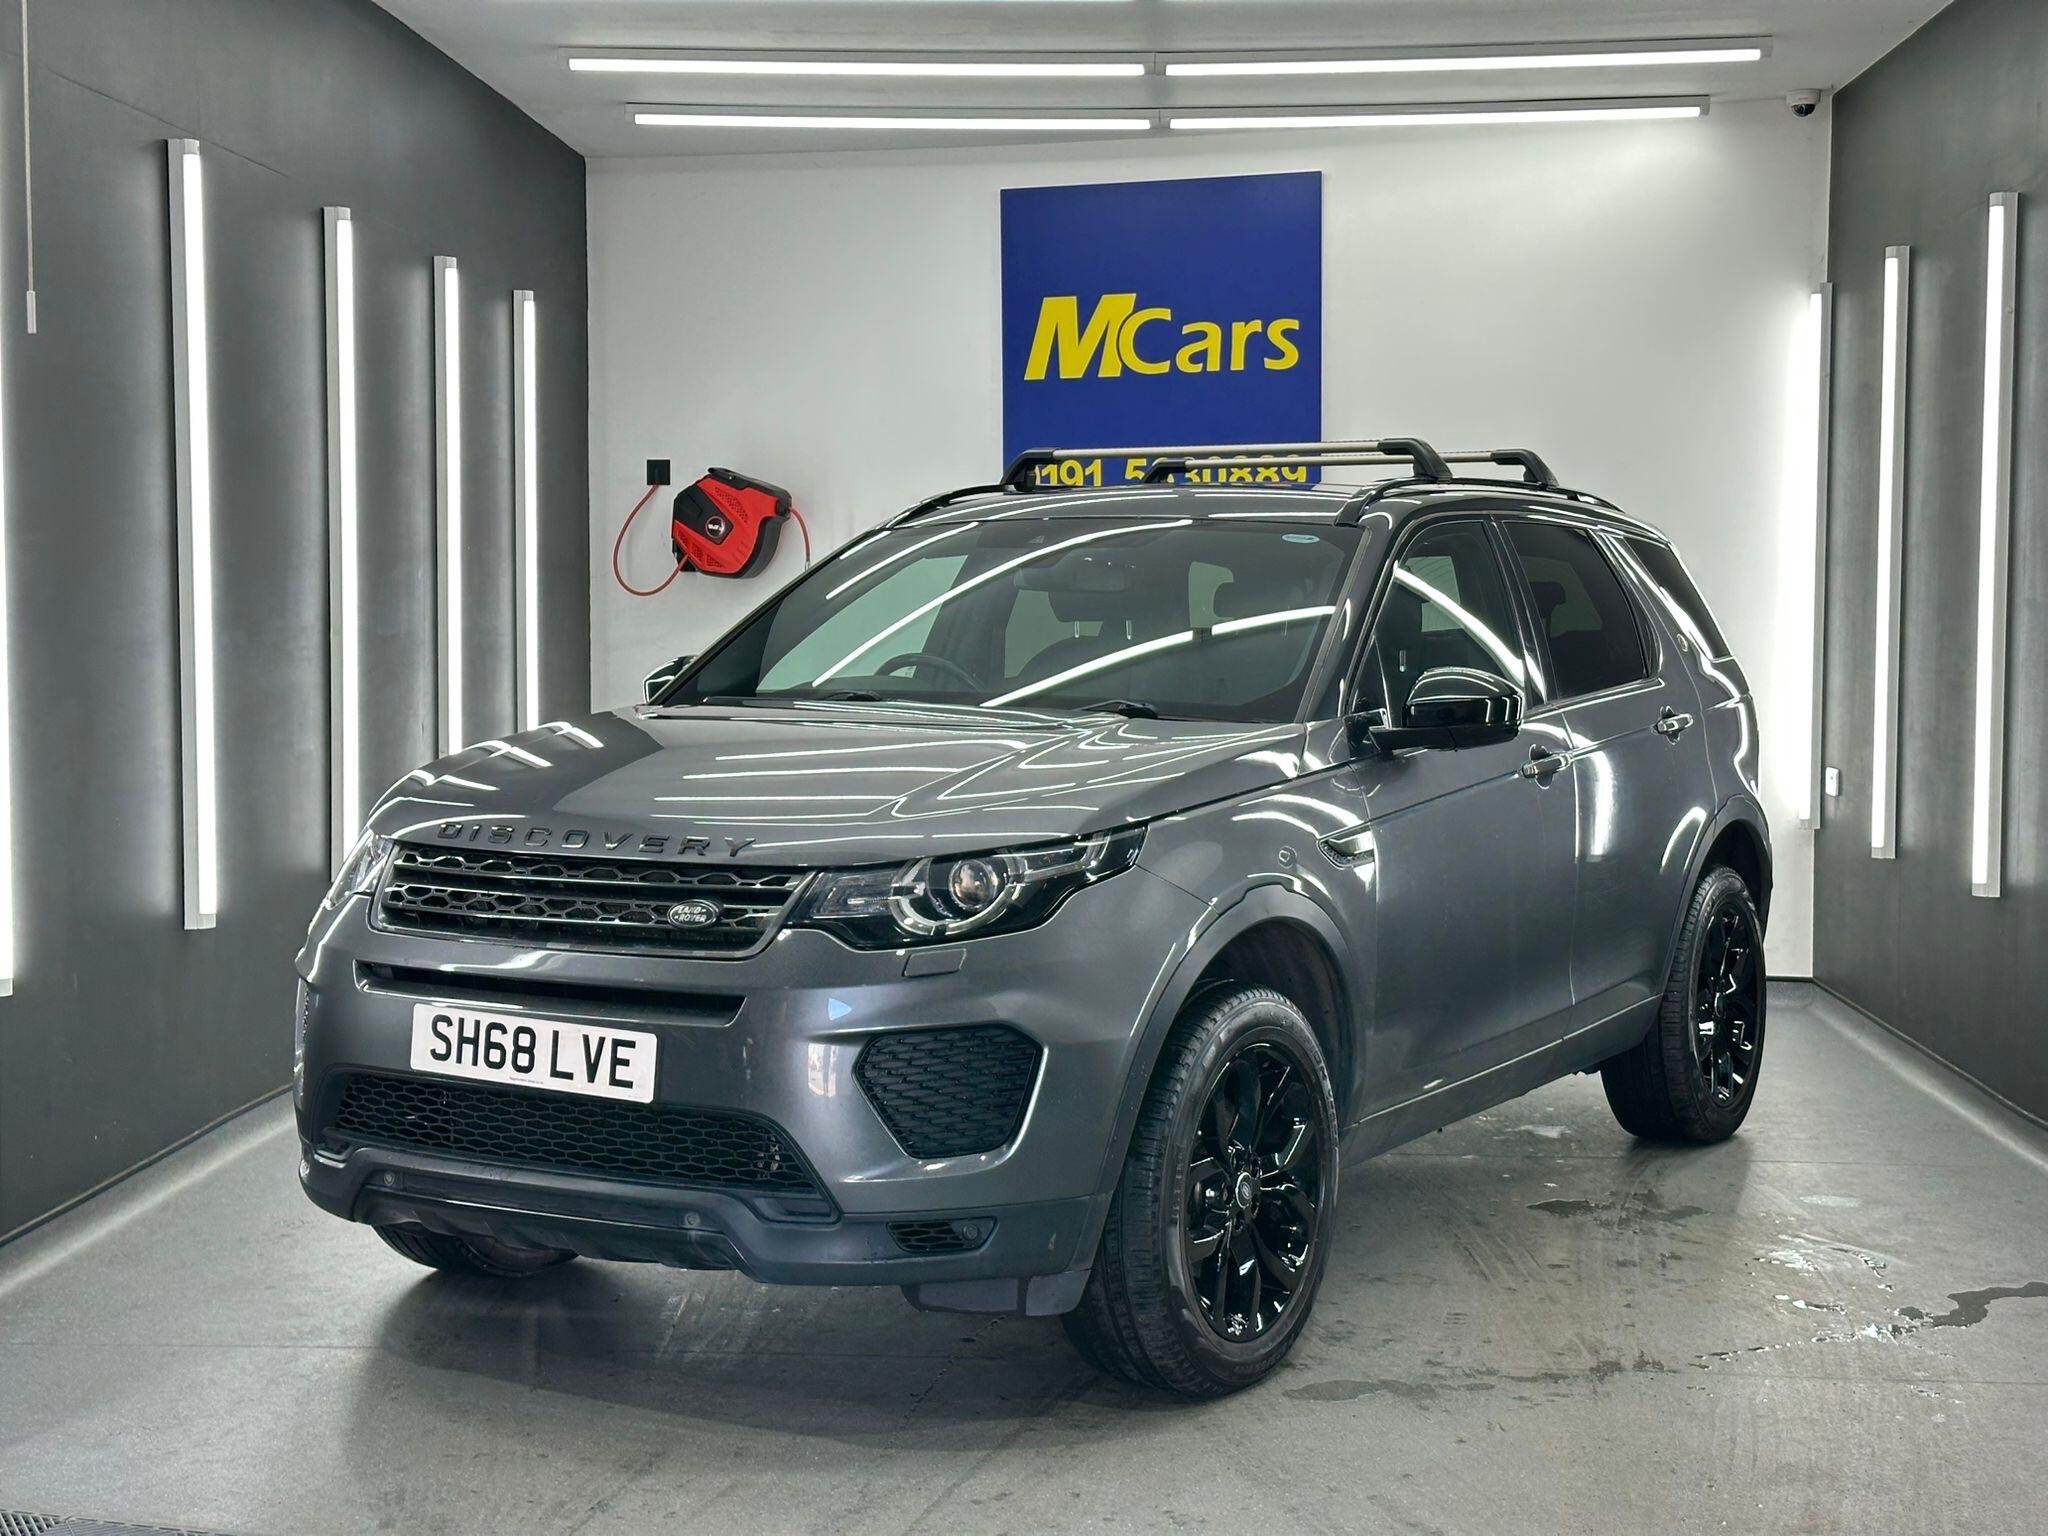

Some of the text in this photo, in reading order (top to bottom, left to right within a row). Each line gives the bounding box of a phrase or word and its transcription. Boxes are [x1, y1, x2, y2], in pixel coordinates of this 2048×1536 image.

[1034, 458, 1102, 487] 191
[437, 822, 757, 858] DISCOVERY
[429, 1014, 637, 1089] SH68 LVE
